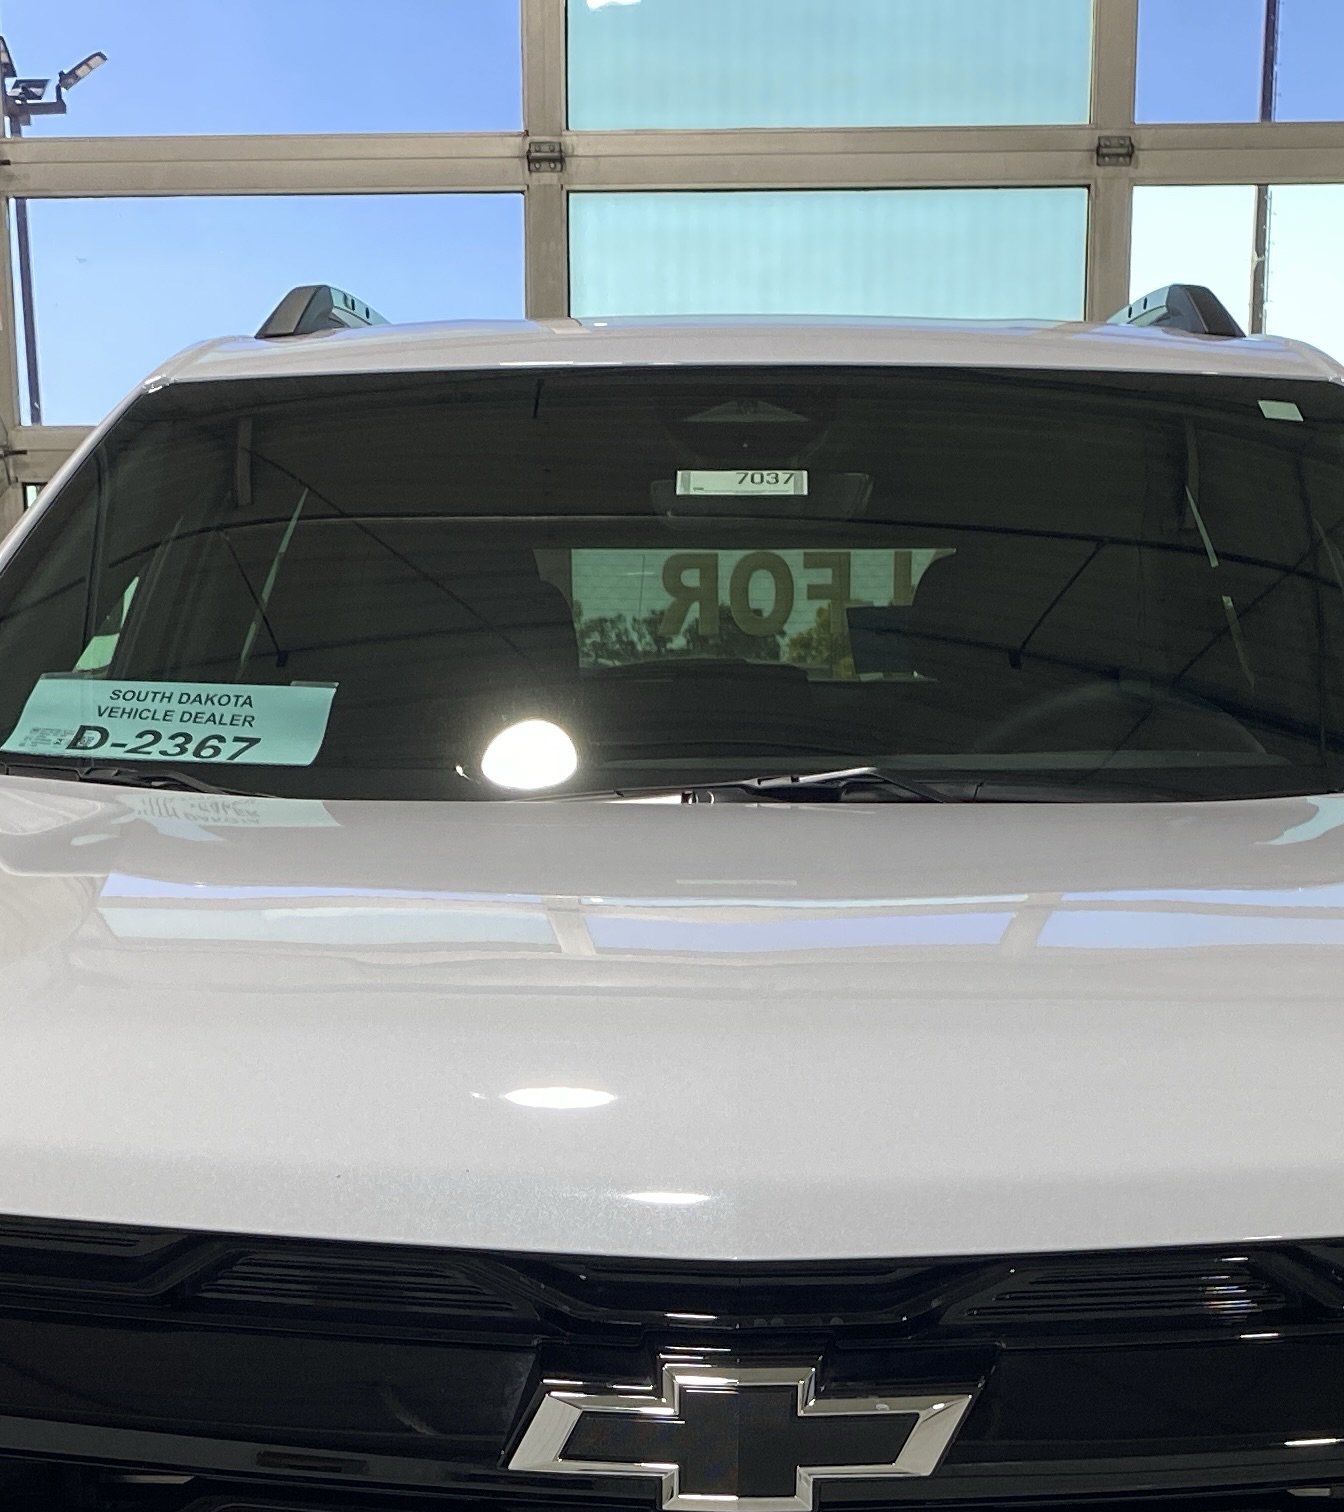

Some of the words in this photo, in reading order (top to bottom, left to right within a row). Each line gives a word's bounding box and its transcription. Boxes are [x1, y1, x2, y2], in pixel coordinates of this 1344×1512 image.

[736, 472, 794, 485] 7037
[109, 689, 174, 704] SOUTH
[177, 692, 254, 709] DAKOTA
[97, 705, 175, 723] VEHICLE
[179, 711, 256, 728] DEALER
[65, 725, 262, 761] D-2367
